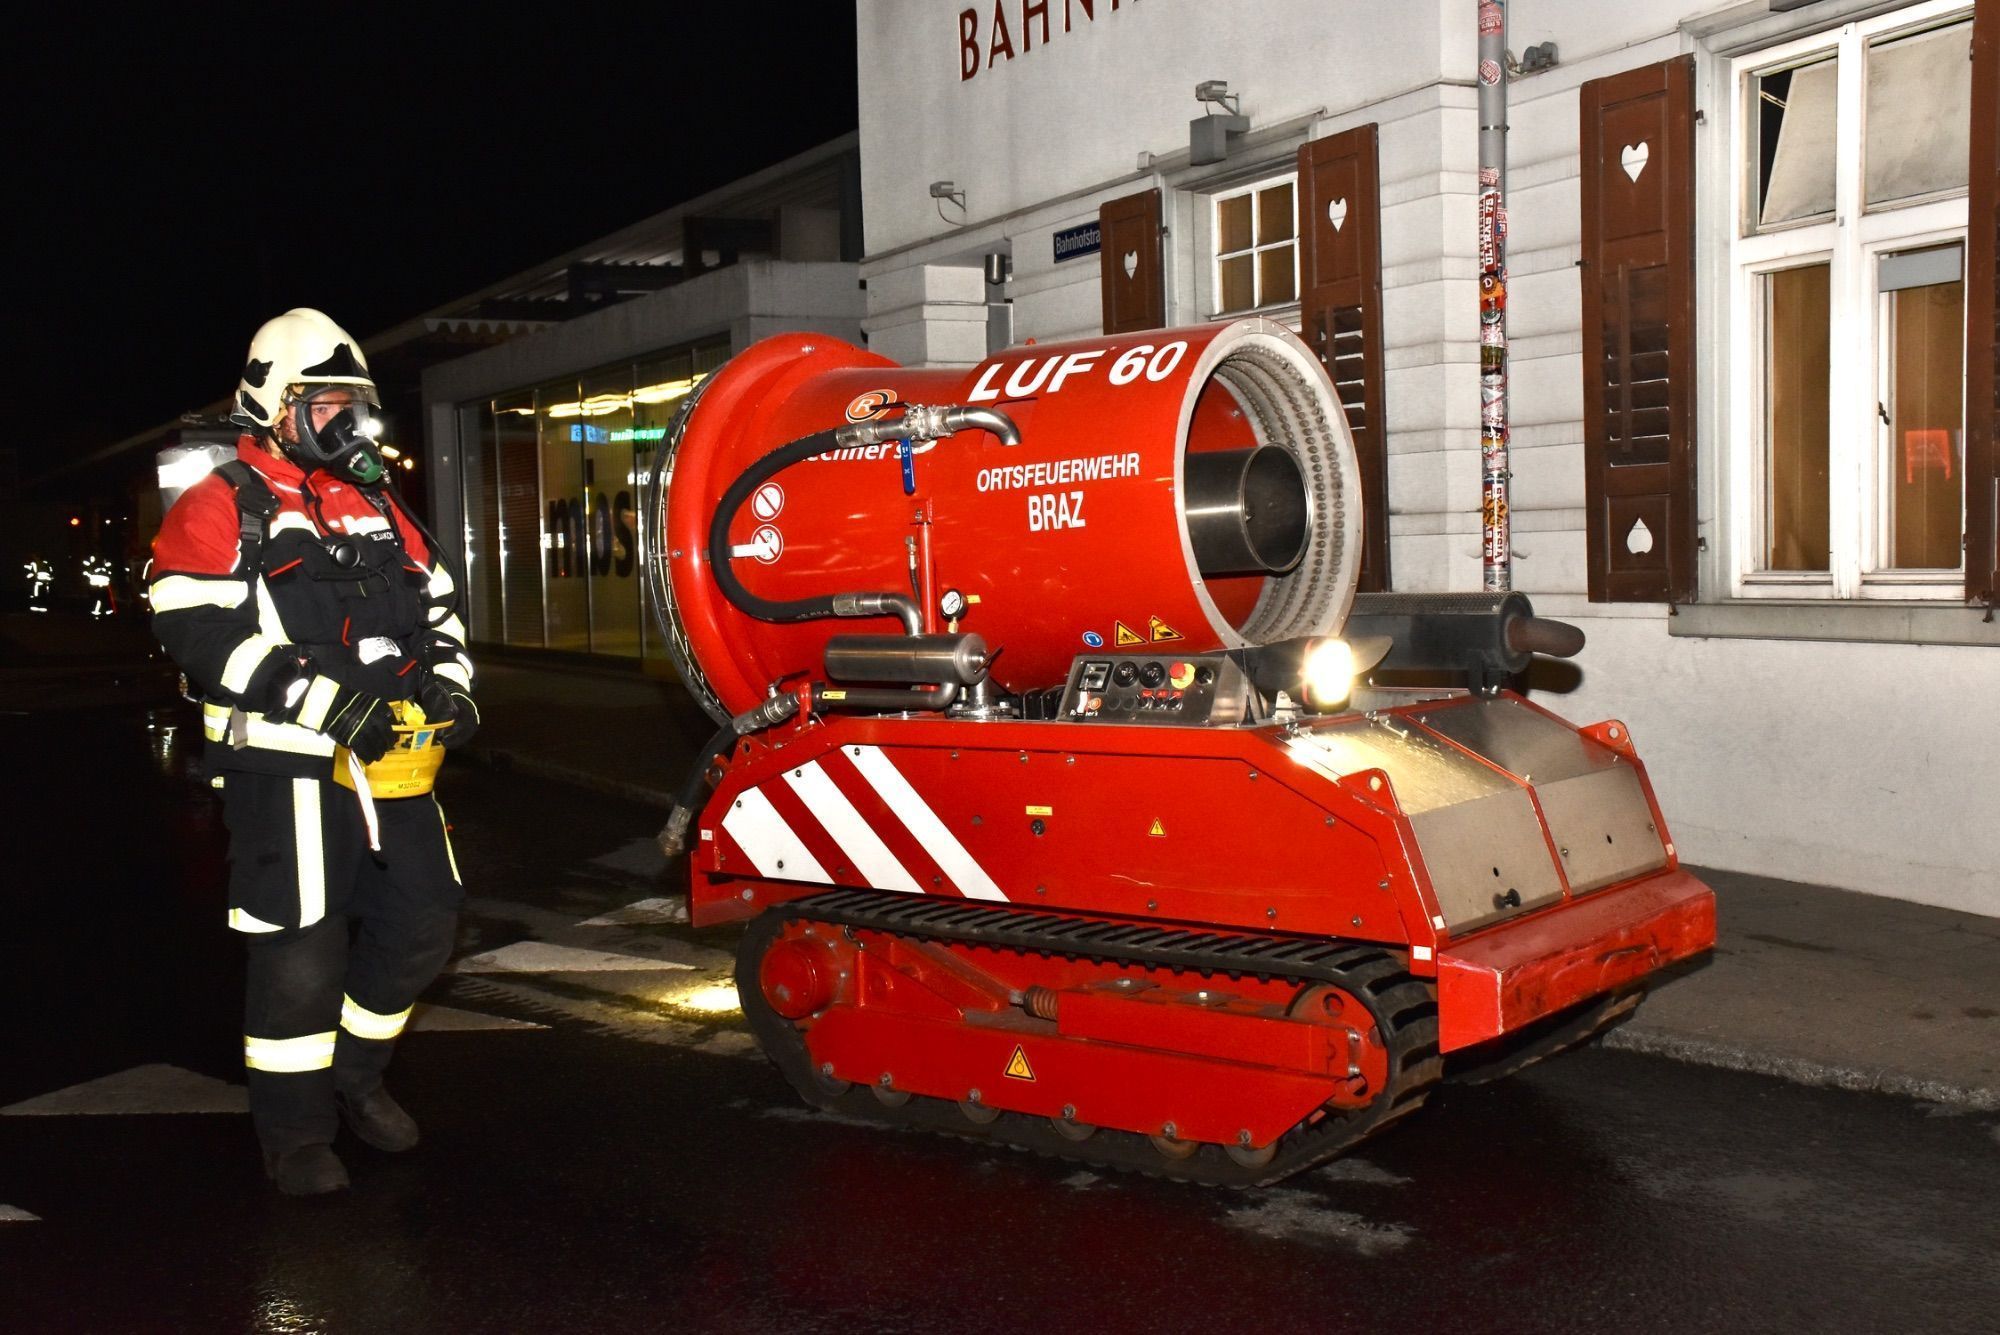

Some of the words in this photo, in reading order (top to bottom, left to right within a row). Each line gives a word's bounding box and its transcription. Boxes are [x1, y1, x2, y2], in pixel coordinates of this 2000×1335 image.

[959, 0, 1138, 82] BAH
[967, 350, 1107, 402] LUF
[1108, 341, 1188, 386] 60
[976, 452, 1140, 492] ORTSFEUERWEHR
[1028, 491, 1086, 532] BRAZ
